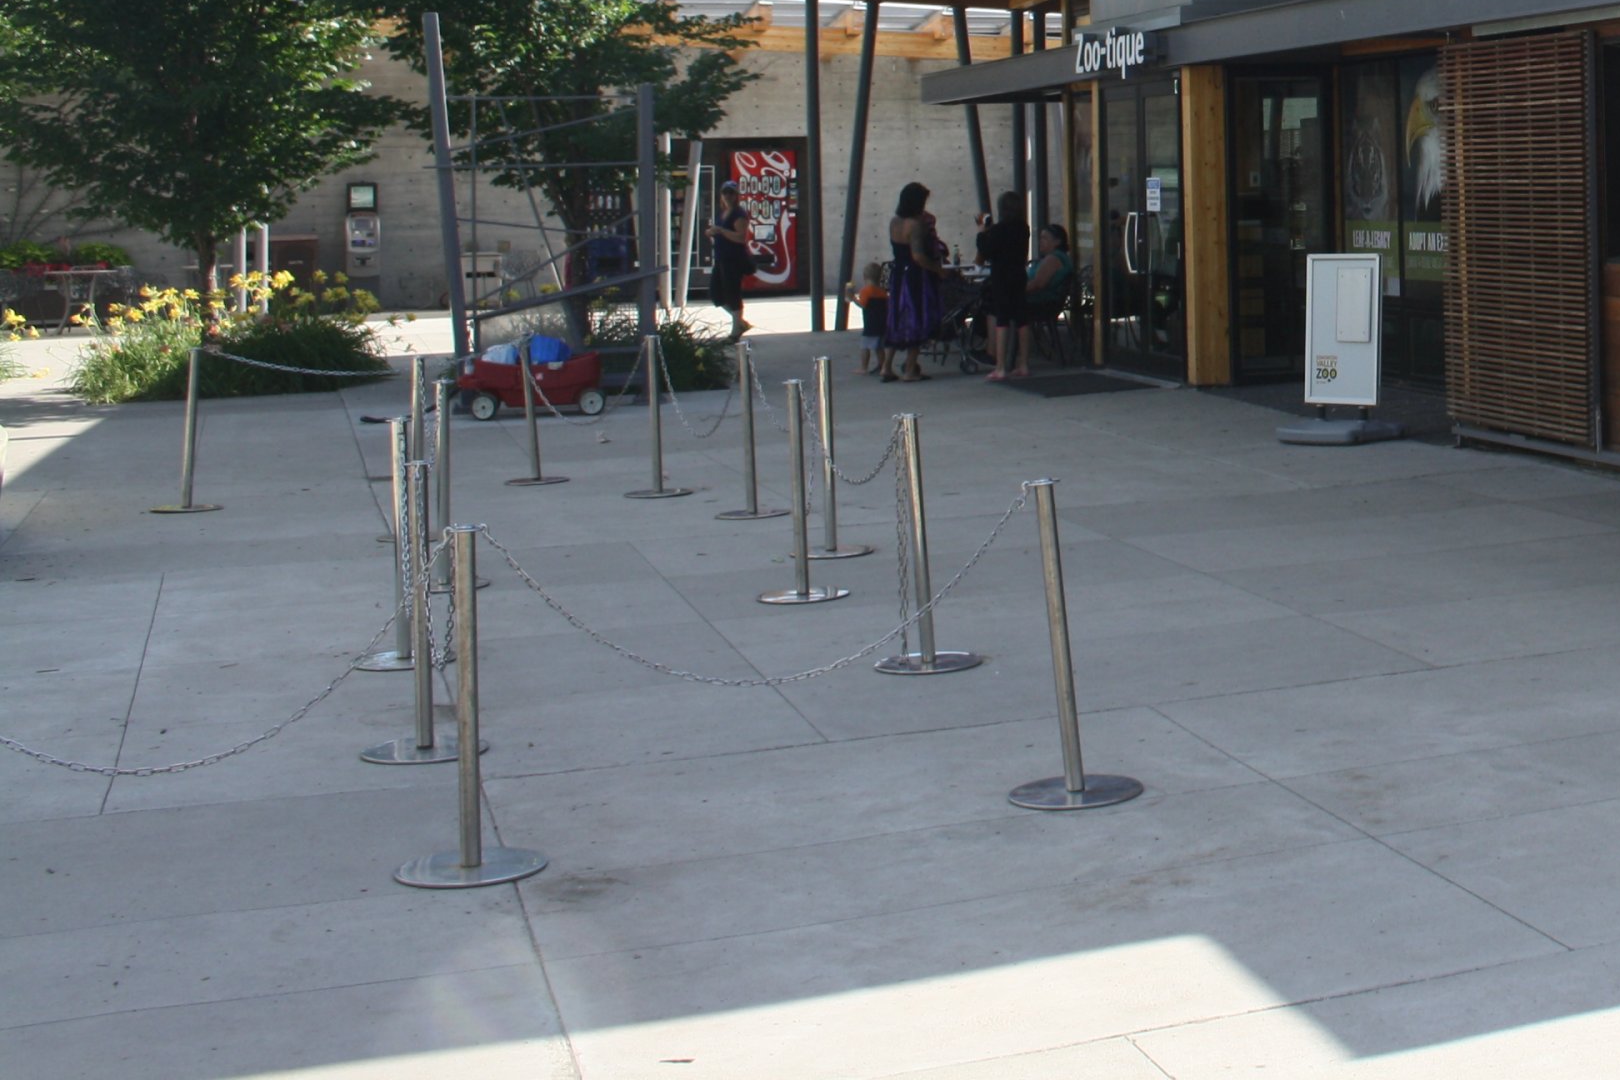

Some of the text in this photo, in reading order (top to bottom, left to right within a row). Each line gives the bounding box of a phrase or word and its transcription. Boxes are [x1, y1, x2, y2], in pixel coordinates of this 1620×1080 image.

[1074, 26, 1145, 79] Zoo-tique
[1316, 360, 1338, 368] VALLEY
[1316, 368, 1338, 380] ZOO
